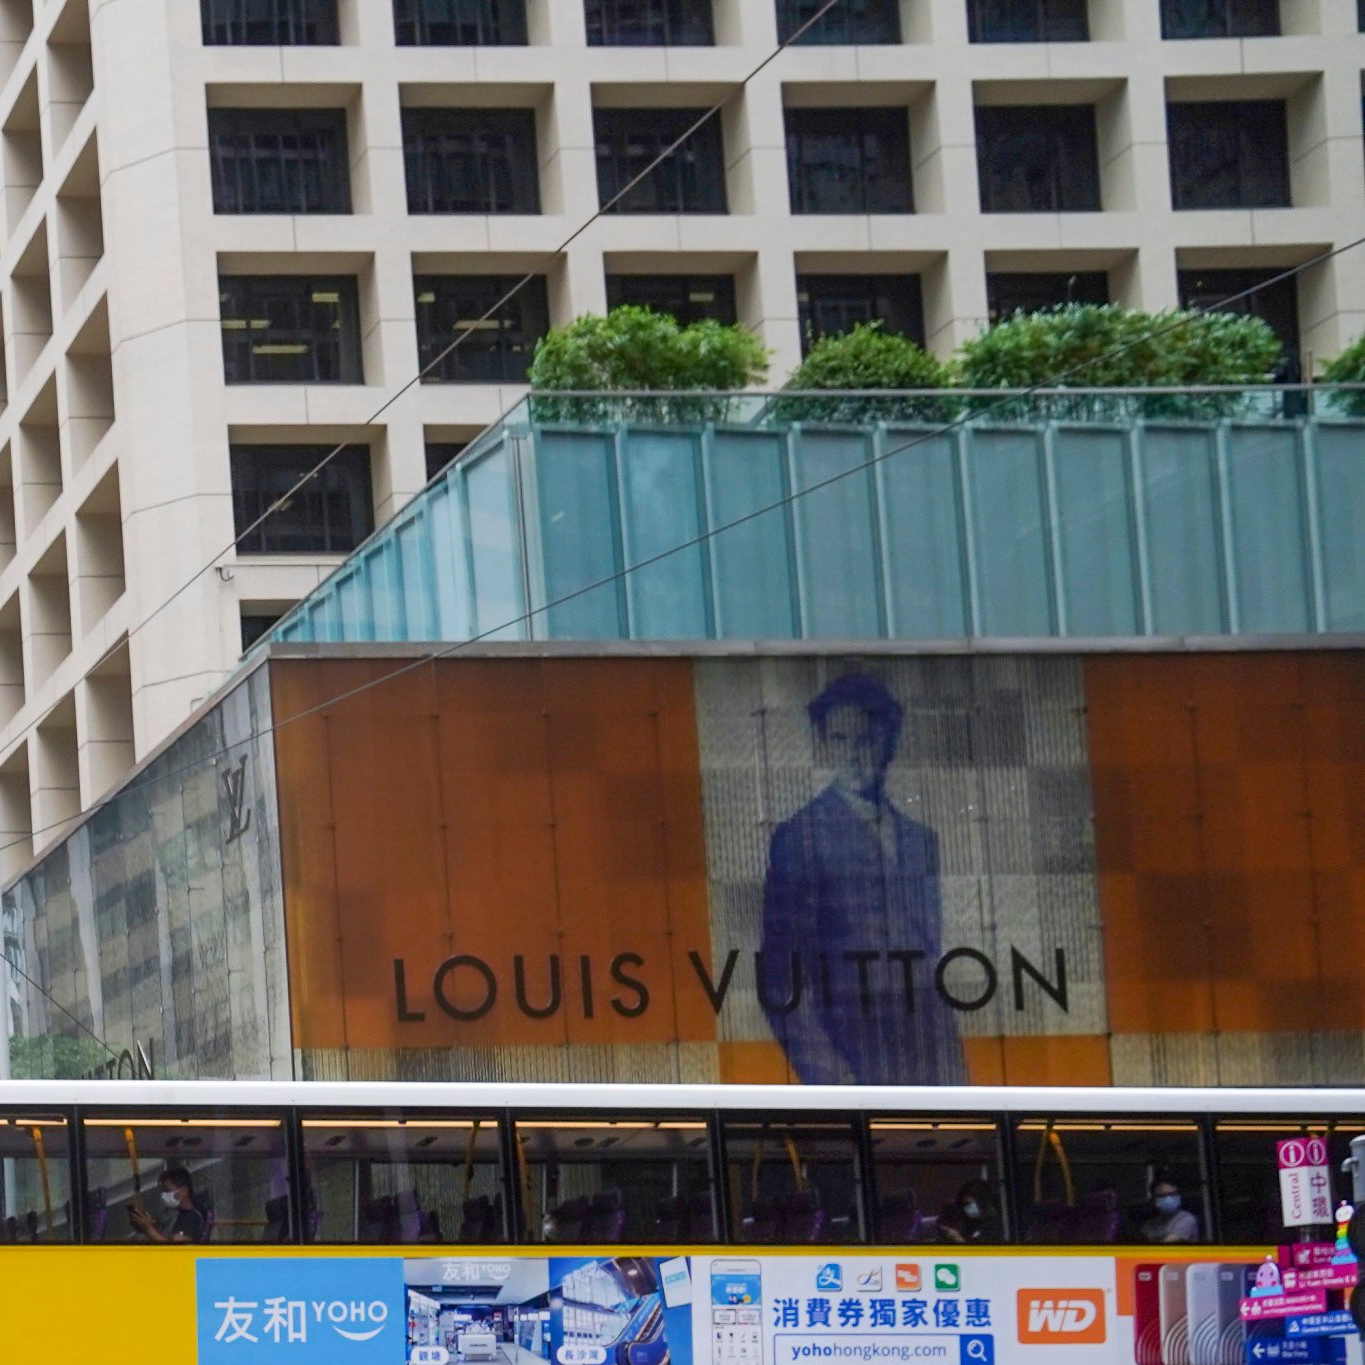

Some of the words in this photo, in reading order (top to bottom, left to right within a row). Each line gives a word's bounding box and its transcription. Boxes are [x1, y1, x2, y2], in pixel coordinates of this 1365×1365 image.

[393, 951, 650, 1022] LOUIS
[688, 944, 1070, 1016] VUITTON
[1289, 1173, 1302, 1219] Central
[1311, 1171, 1329, 1217] 中環
[442, 1262, 481, 1281] 友和
[481, 1263, 511, 1274] YOHO
[214, 1296, 307, 1344] 友和
[311, 1301, 388, 1323] YOHO
[773, 1298, 993, 1328] 消費券獨家優惠
[1028, 1300, 1097, 1332] WD
[792, 1343, 947, 1360] yohohongkong.com
